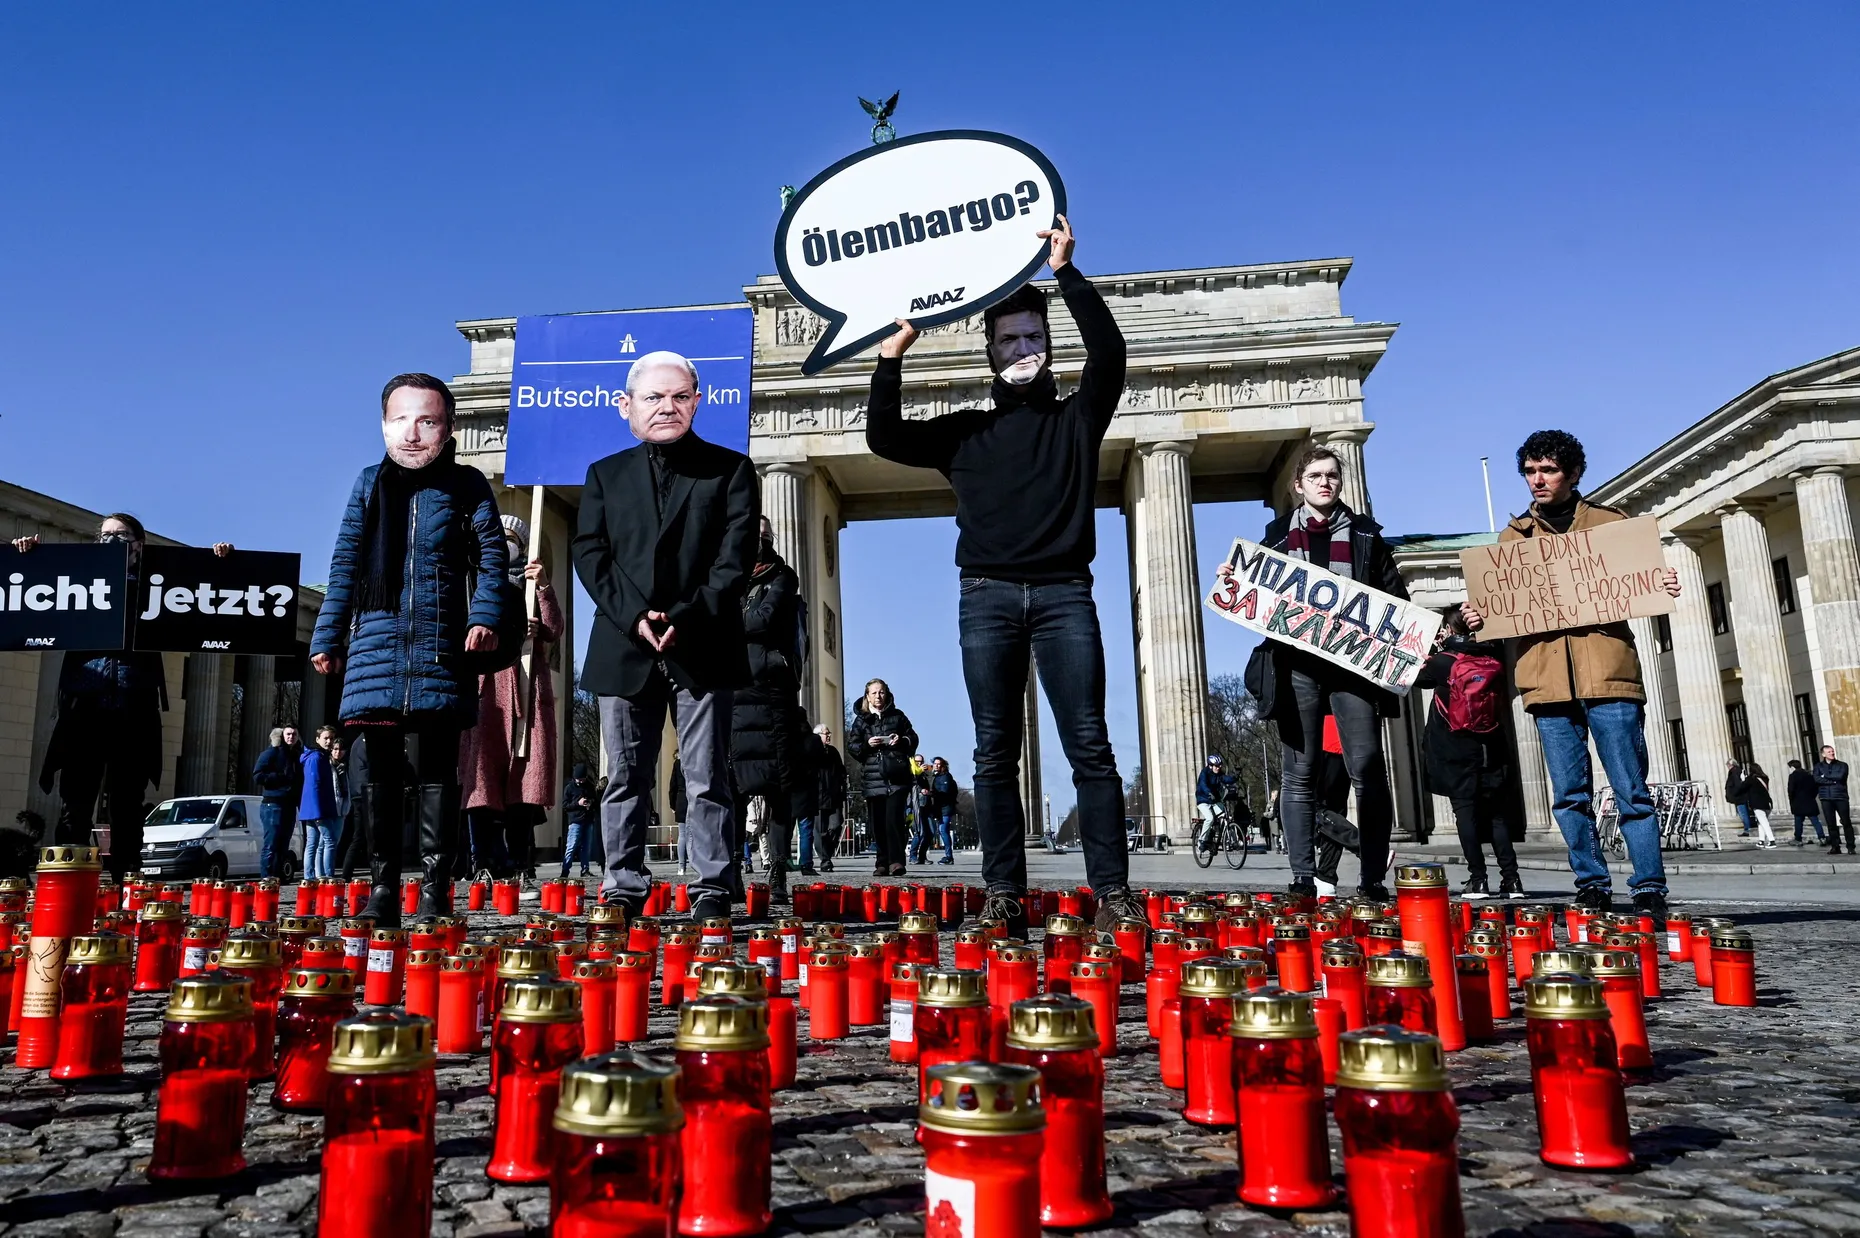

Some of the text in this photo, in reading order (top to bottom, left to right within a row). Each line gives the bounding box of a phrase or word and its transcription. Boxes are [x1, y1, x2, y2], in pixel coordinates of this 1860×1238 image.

[802, 180, 1040, 267] Ölembargo?
[909, 287, 966, 313] AVAAZ
[707, 384, 741, 405] km
[1487, 528, 1593, 569] WE DIDN'T
[0, 573, 112, 611] icht
[1483, 553, 1609, 593] CHOOSE HIM
[140, 574, 294, 621] jetzt?
[1212, 576, 1258, 621] ЗА
[1475, 567, 1665, 619] YOU ARE CHOOSING
[1505, 598, 1633, 636] TO PAY HIM
[25, 637, 56, 647] AVAAZ
[201, 640, 231, 650] AVAAZ
